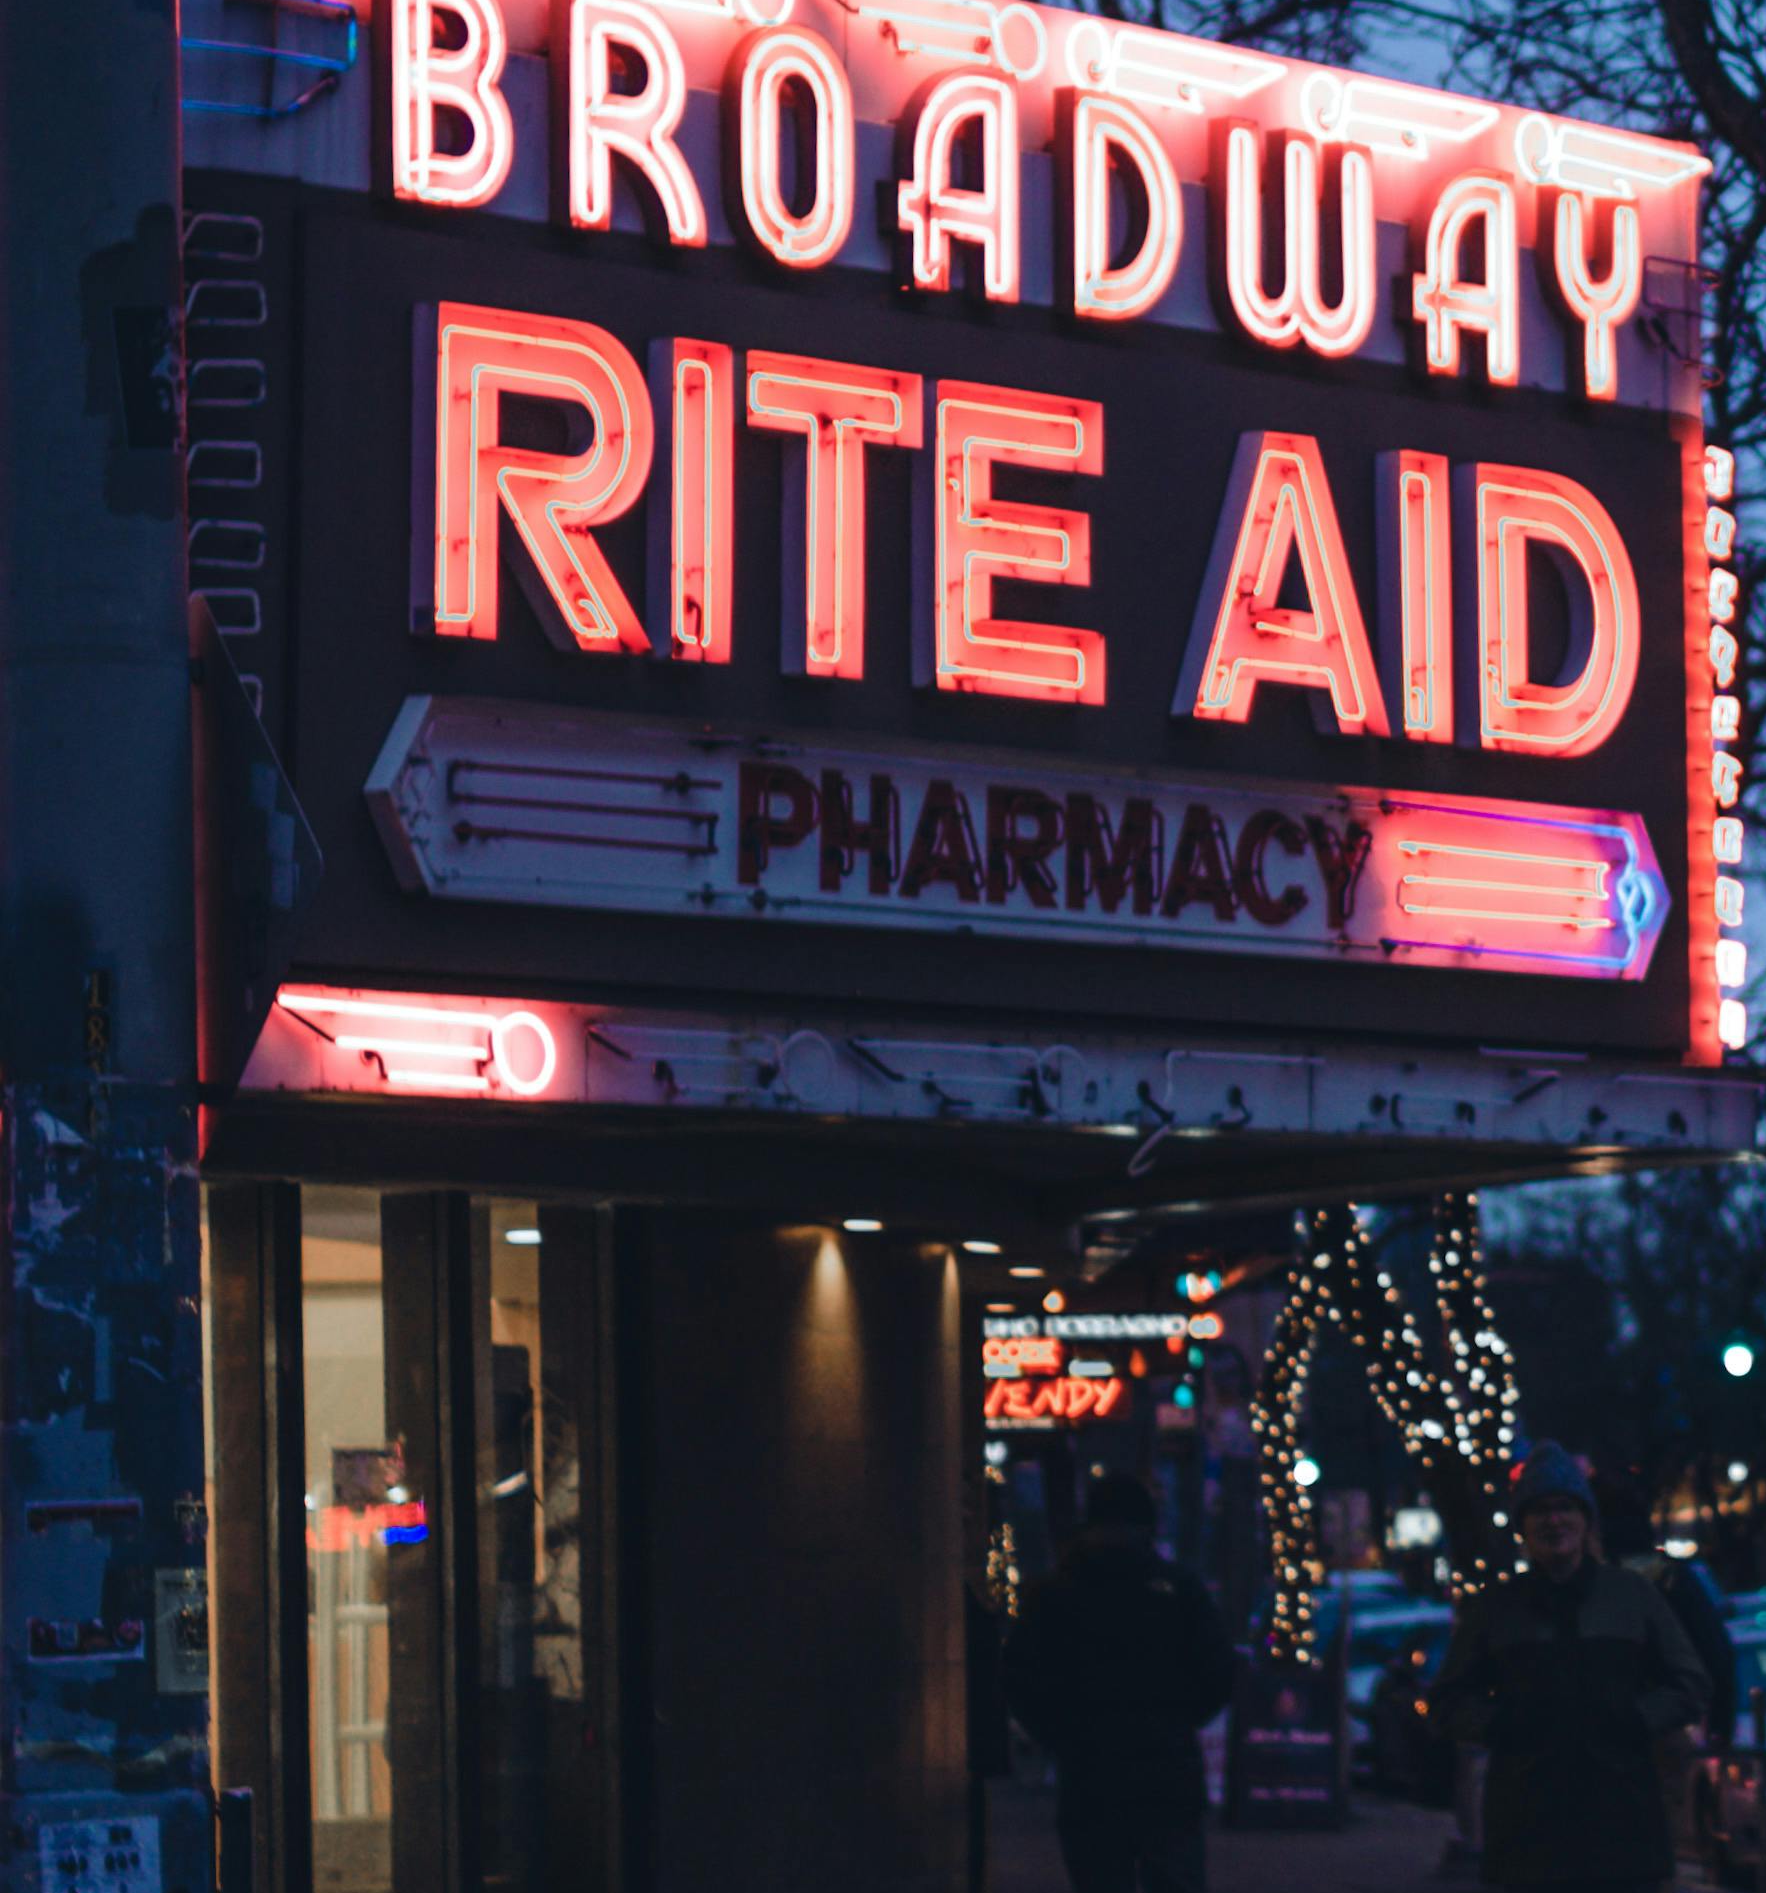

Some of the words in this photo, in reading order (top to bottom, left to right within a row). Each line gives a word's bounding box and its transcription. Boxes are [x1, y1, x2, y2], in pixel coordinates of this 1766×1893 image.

[424, 301, 1106, 707] RITE
[1185, 430, 1642, 760] AID
[735, 760, 1374, 932] PHARMACY
[984, 1377, 1122, 1419] ENDY
